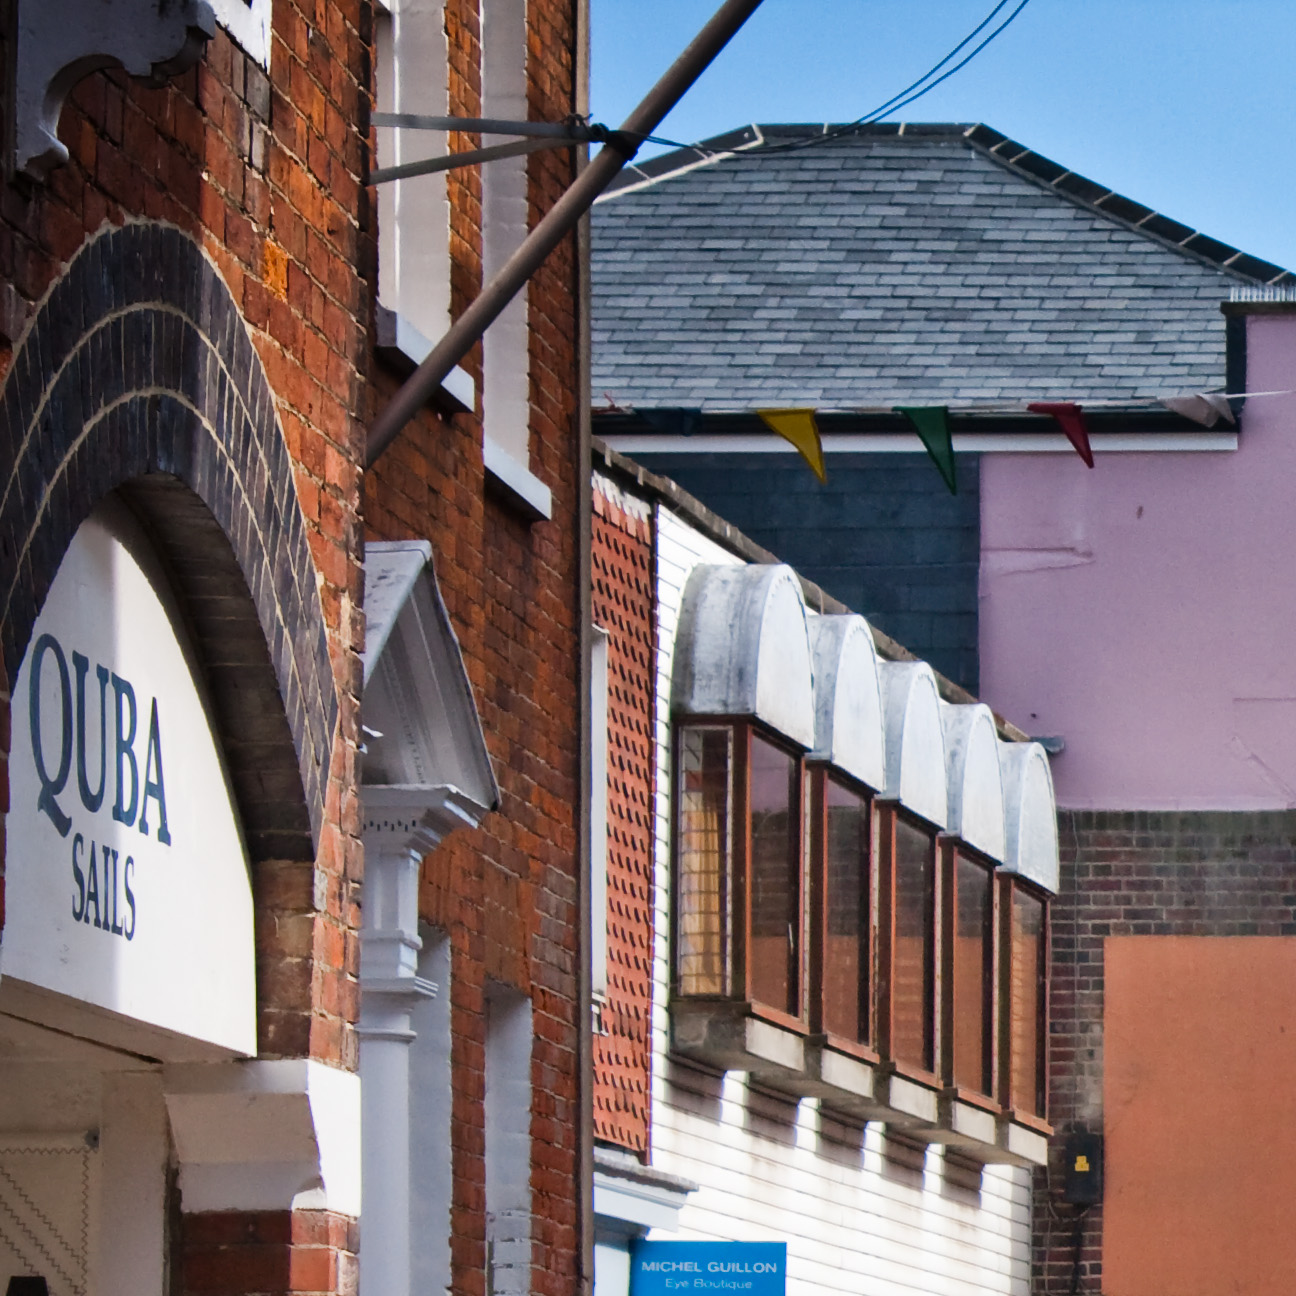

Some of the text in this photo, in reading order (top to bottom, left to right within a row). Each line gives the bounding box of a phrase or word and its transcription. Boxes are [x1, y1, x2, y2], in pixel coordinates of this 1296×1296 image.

[29, 632, 172, 847] QUBA
[72, 832, 136, 942] SAILS
[641, 1261, 777, 1274] MICHEL GUILLON
[665, 1278, 753, 1290] Eye Boutique
